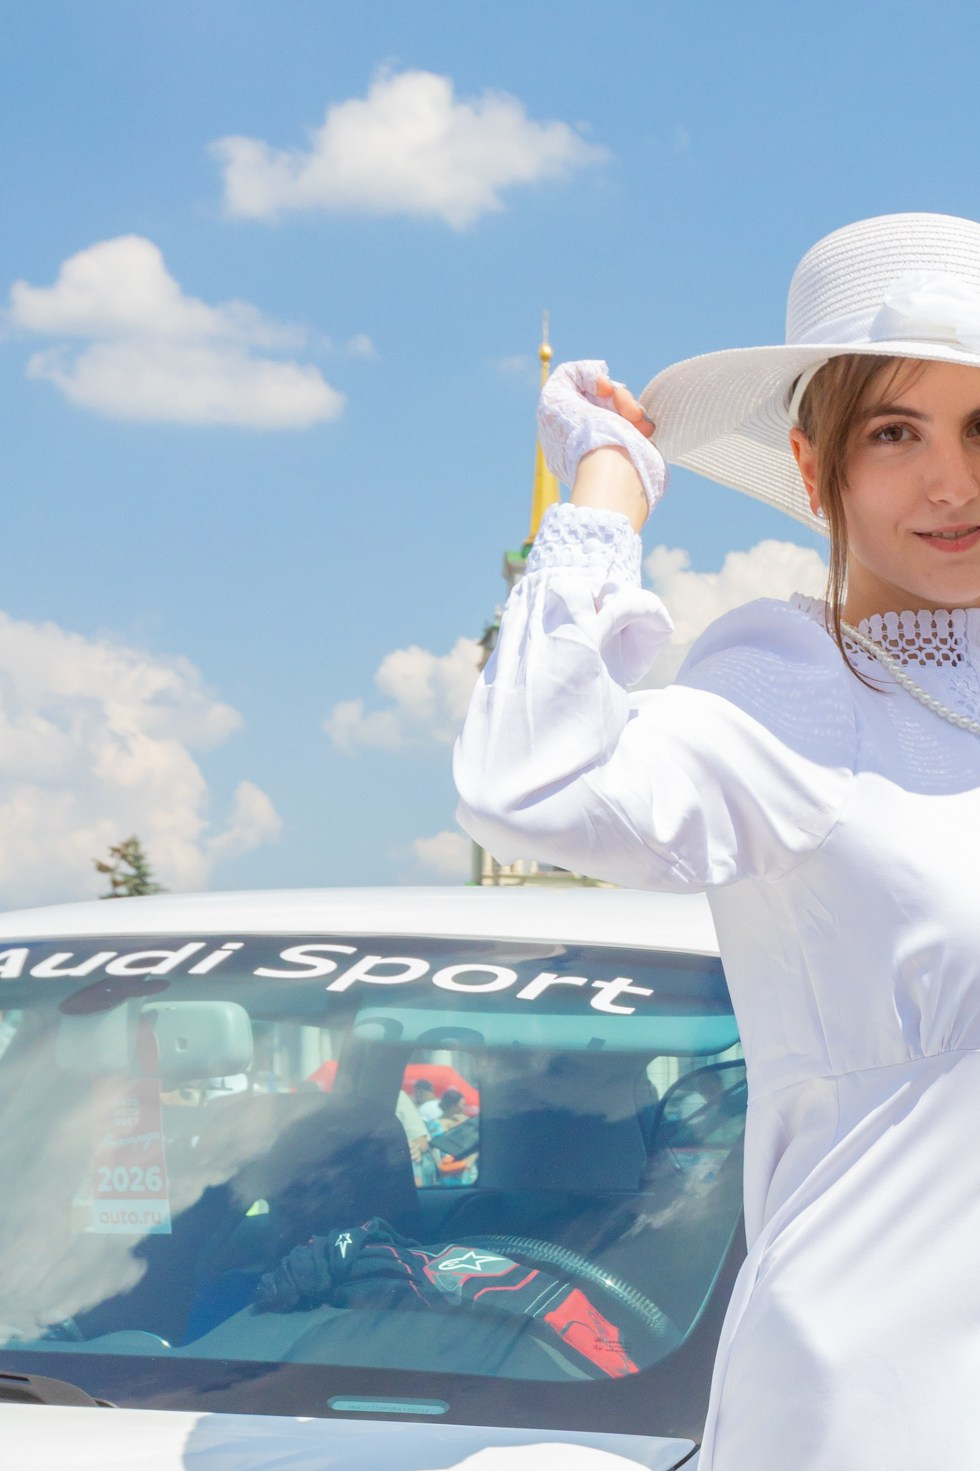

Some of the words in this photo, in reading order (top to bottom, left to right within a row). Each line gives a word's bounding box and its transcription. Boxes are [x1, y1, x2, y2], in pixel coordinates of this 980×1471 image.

[0, 942, 244, 979] Audi
[253, 943, 654, 1015] Sport
[97, 1166, 163, 1192] 2026
[99, 1210, 162, 1225] auto.ru
